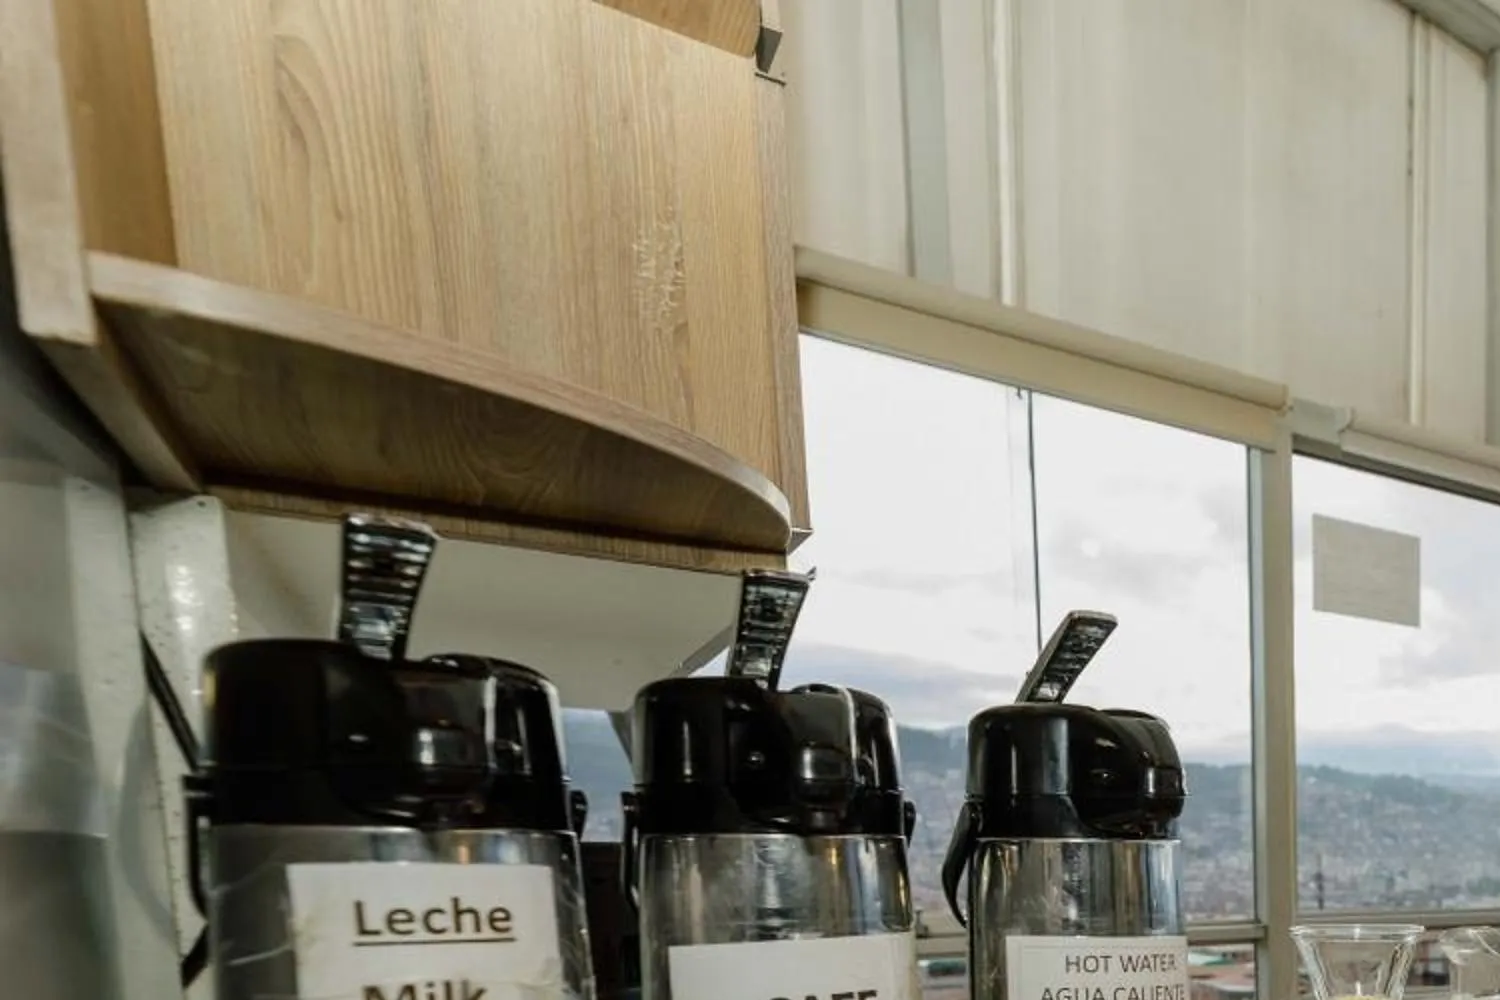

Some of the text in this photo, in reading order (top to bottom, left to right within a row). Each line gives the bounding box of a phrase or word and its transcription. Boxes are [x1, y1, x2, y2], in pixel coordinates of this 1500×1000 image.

[353, 896, 513, 936] Leche
[1065, 953, 1178, 974] HOT WATER
